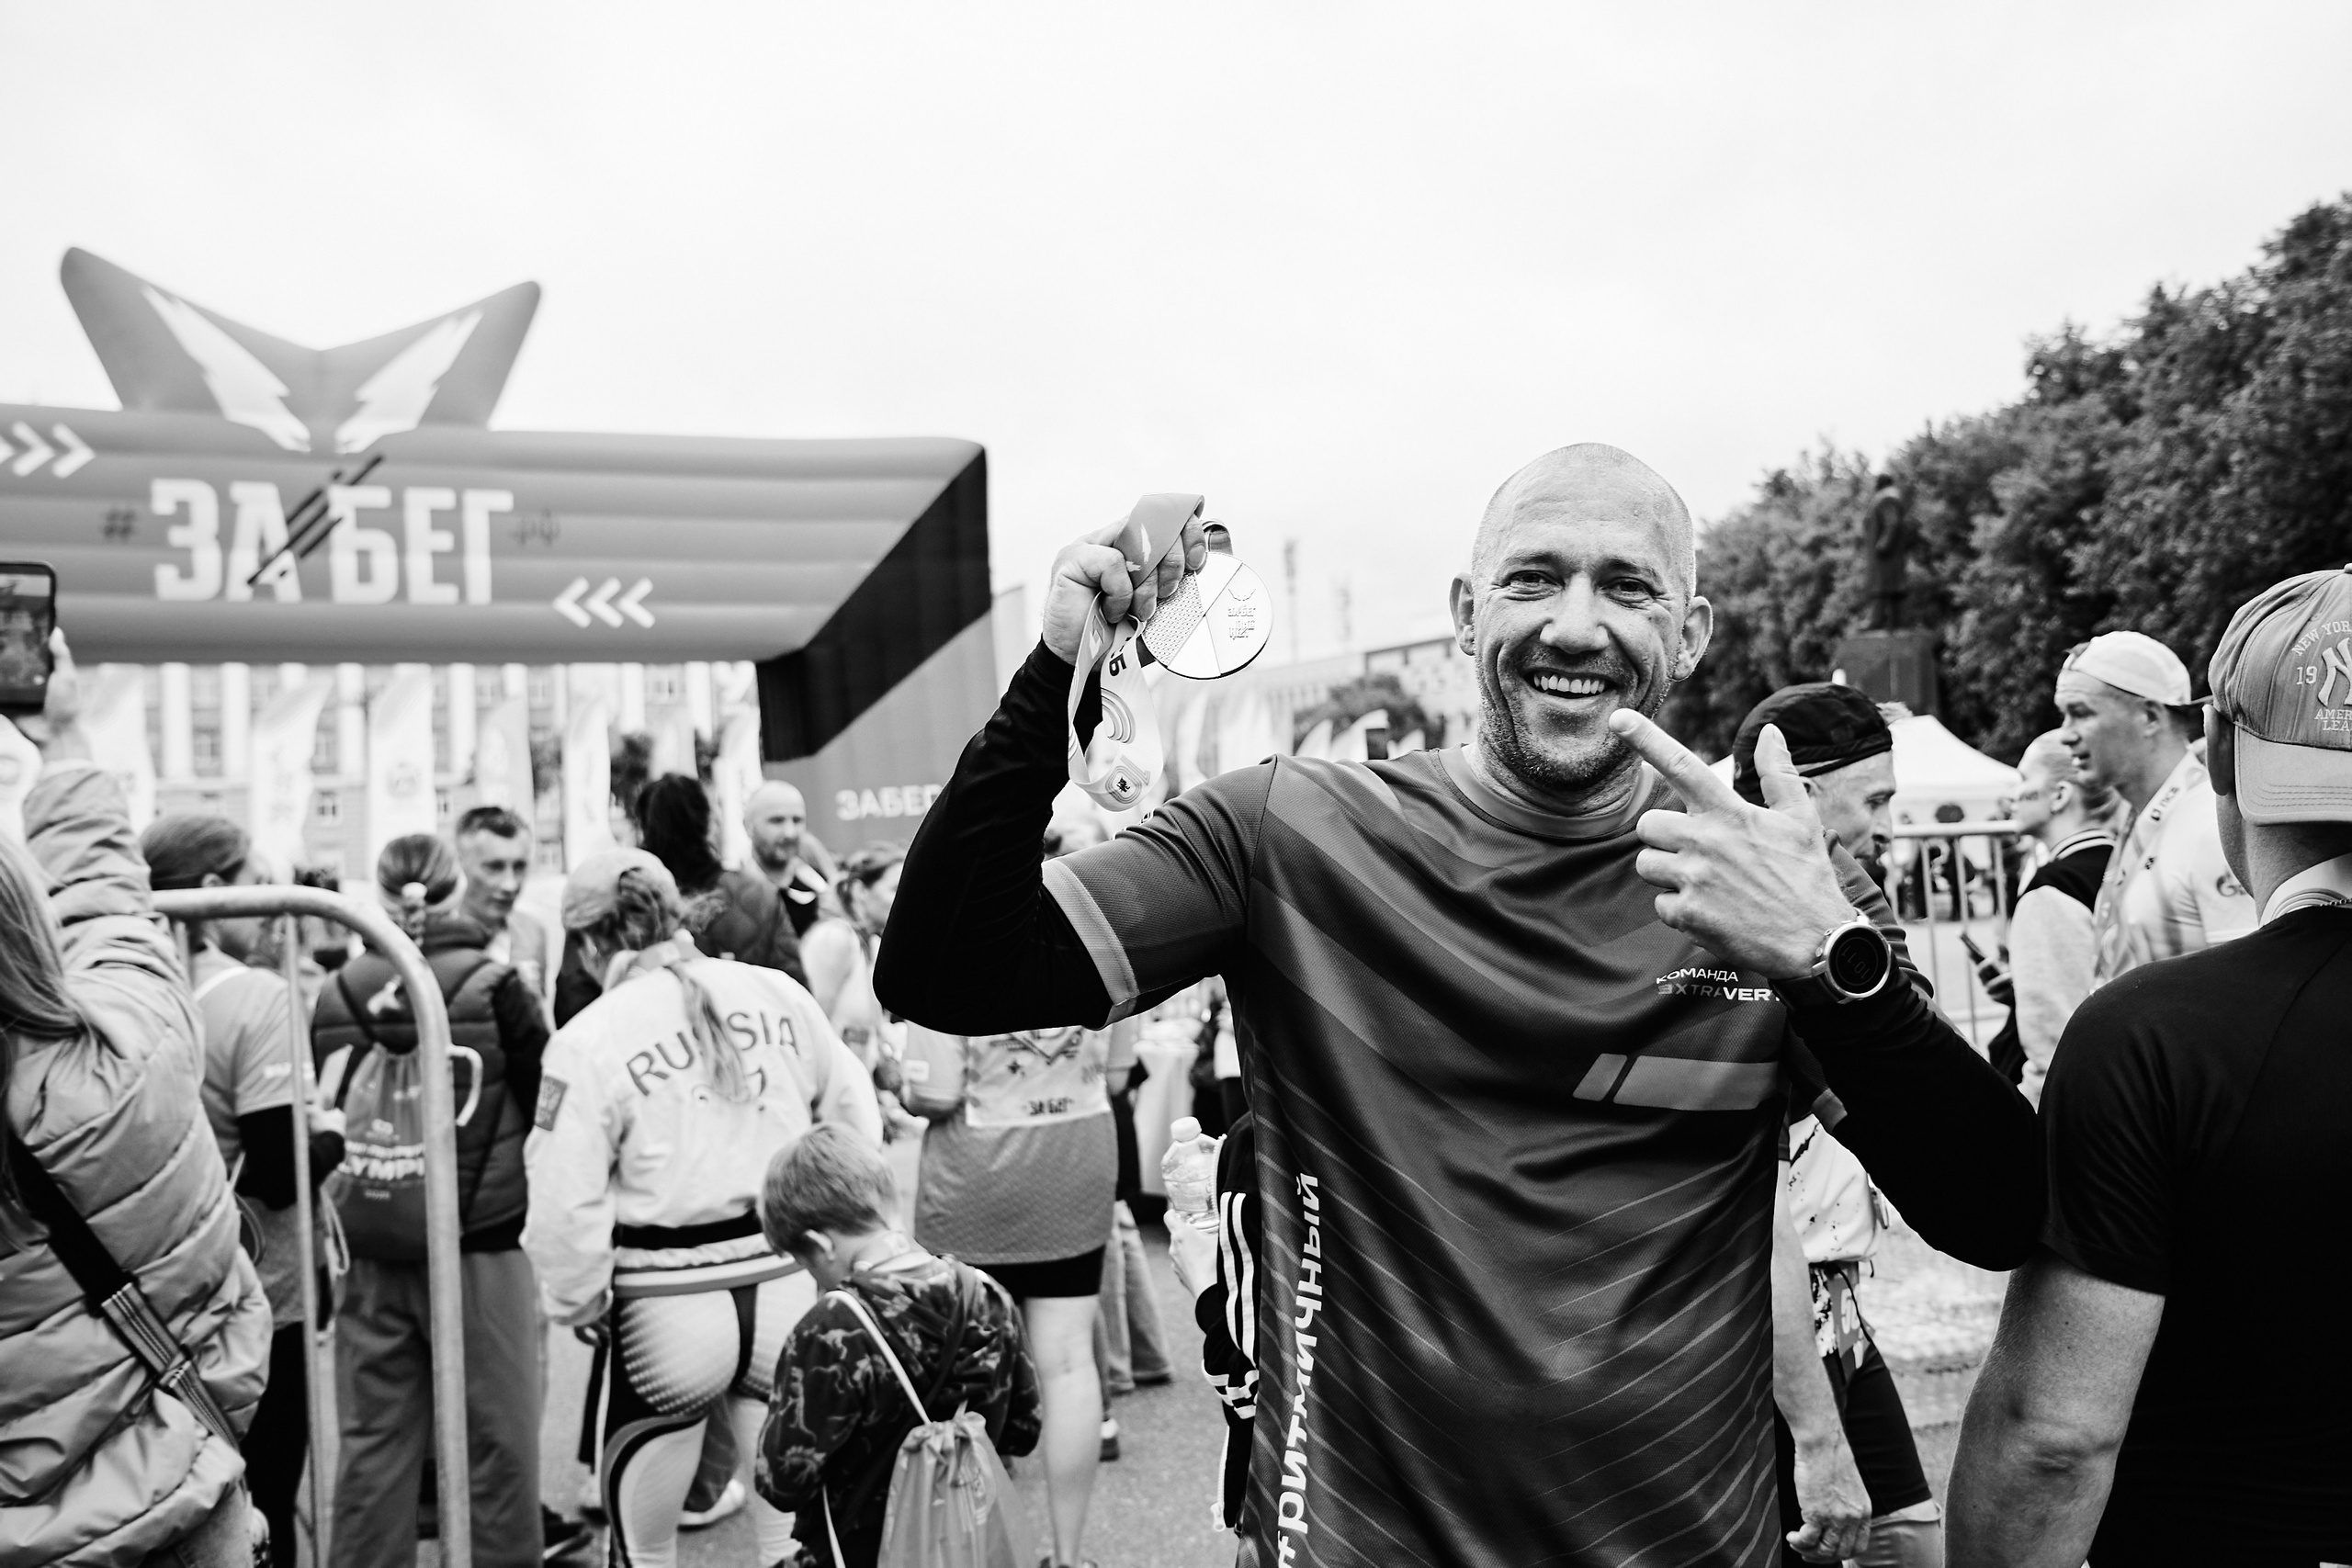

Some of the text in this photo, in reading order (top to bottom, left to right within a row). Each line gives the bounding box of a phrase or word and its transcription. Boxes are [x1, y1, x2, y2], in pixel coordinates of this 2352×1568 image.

[2291, 620, 2352, 657] NEW YOR
[2296, 665, 2318, 685] 19
[2313, 708, 2352, 720] AMER
[2322, 720, 2352, 732] LEA
[1656, 967, 1738, 985] КОМАНДА
[626, 1011, 800, 1098] RUSIA
